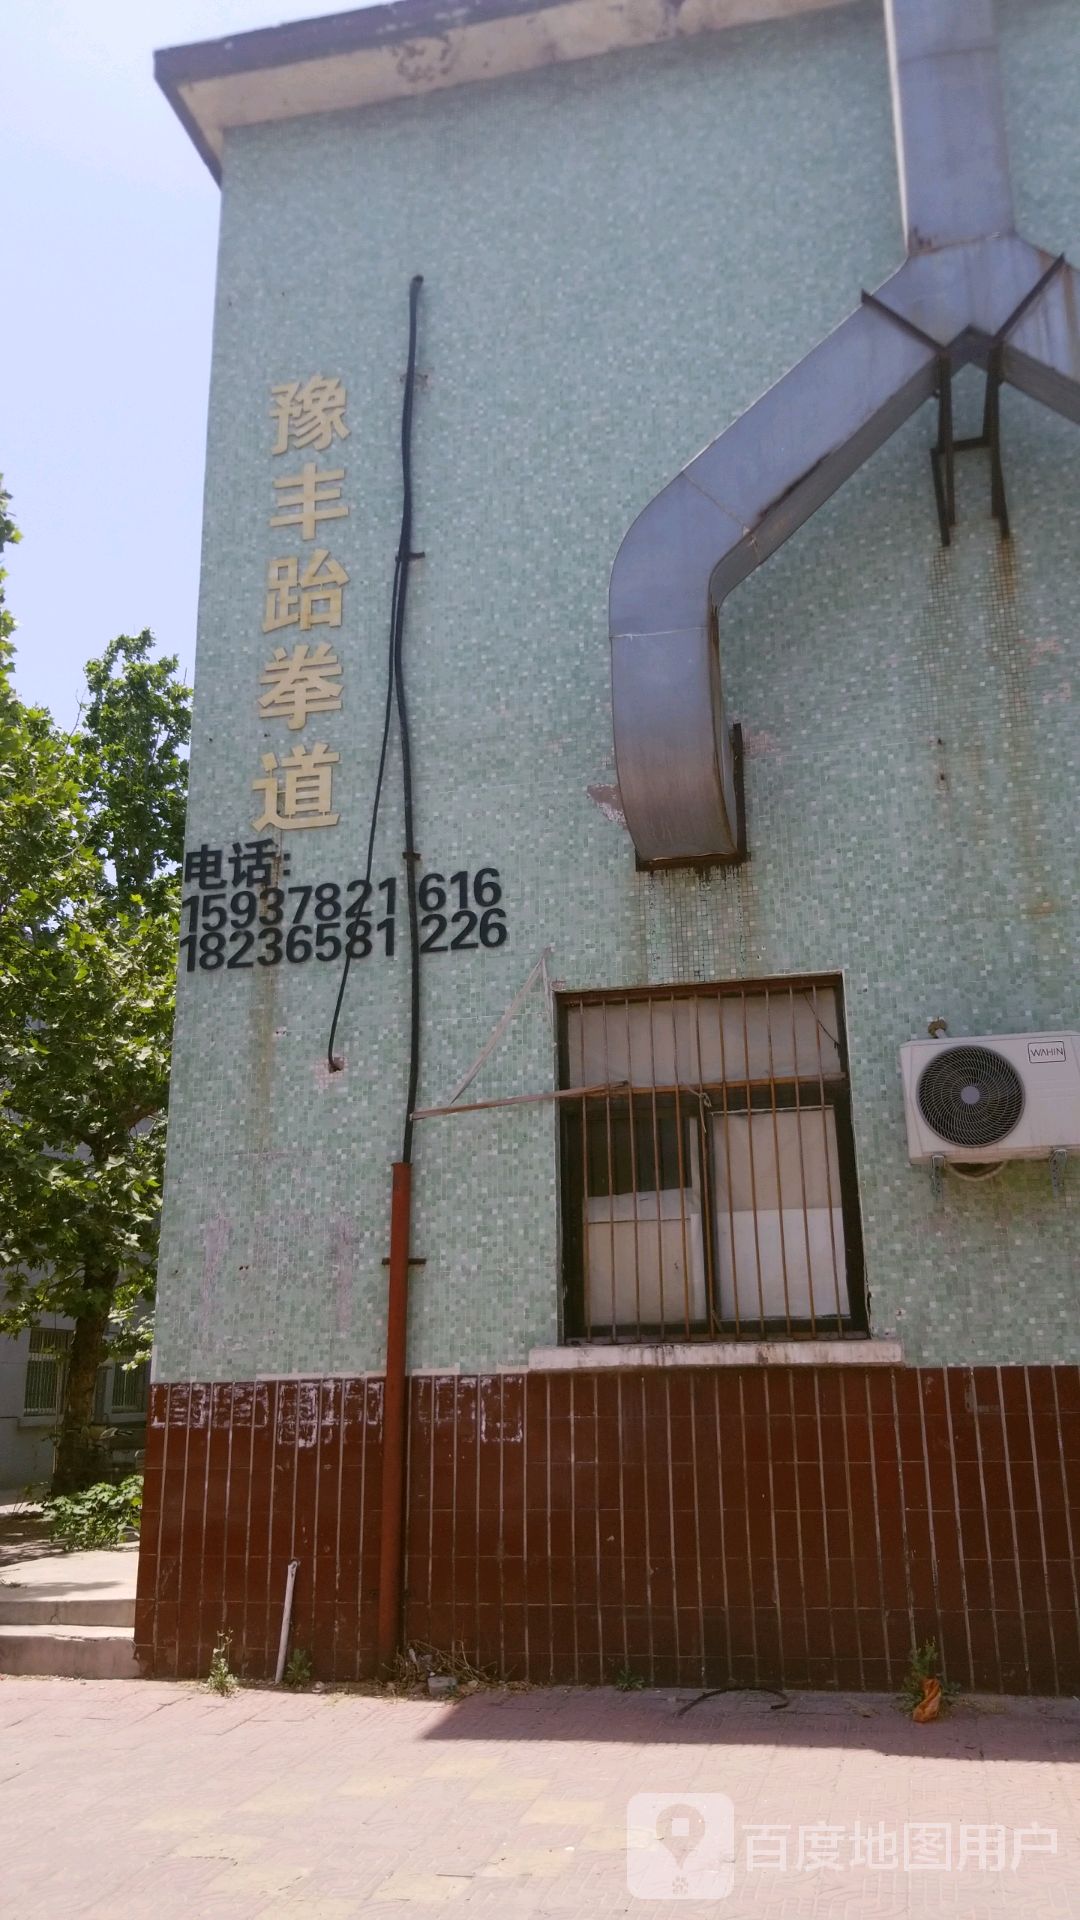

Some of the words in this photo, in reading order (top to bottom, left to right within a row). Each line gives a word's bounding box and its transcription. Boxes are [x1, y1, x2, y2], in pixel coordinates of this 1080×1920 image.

[252, 372, 350, 832] 豫丰跆拳道
[1030, 1047, 1064, 1057] WAHIN
